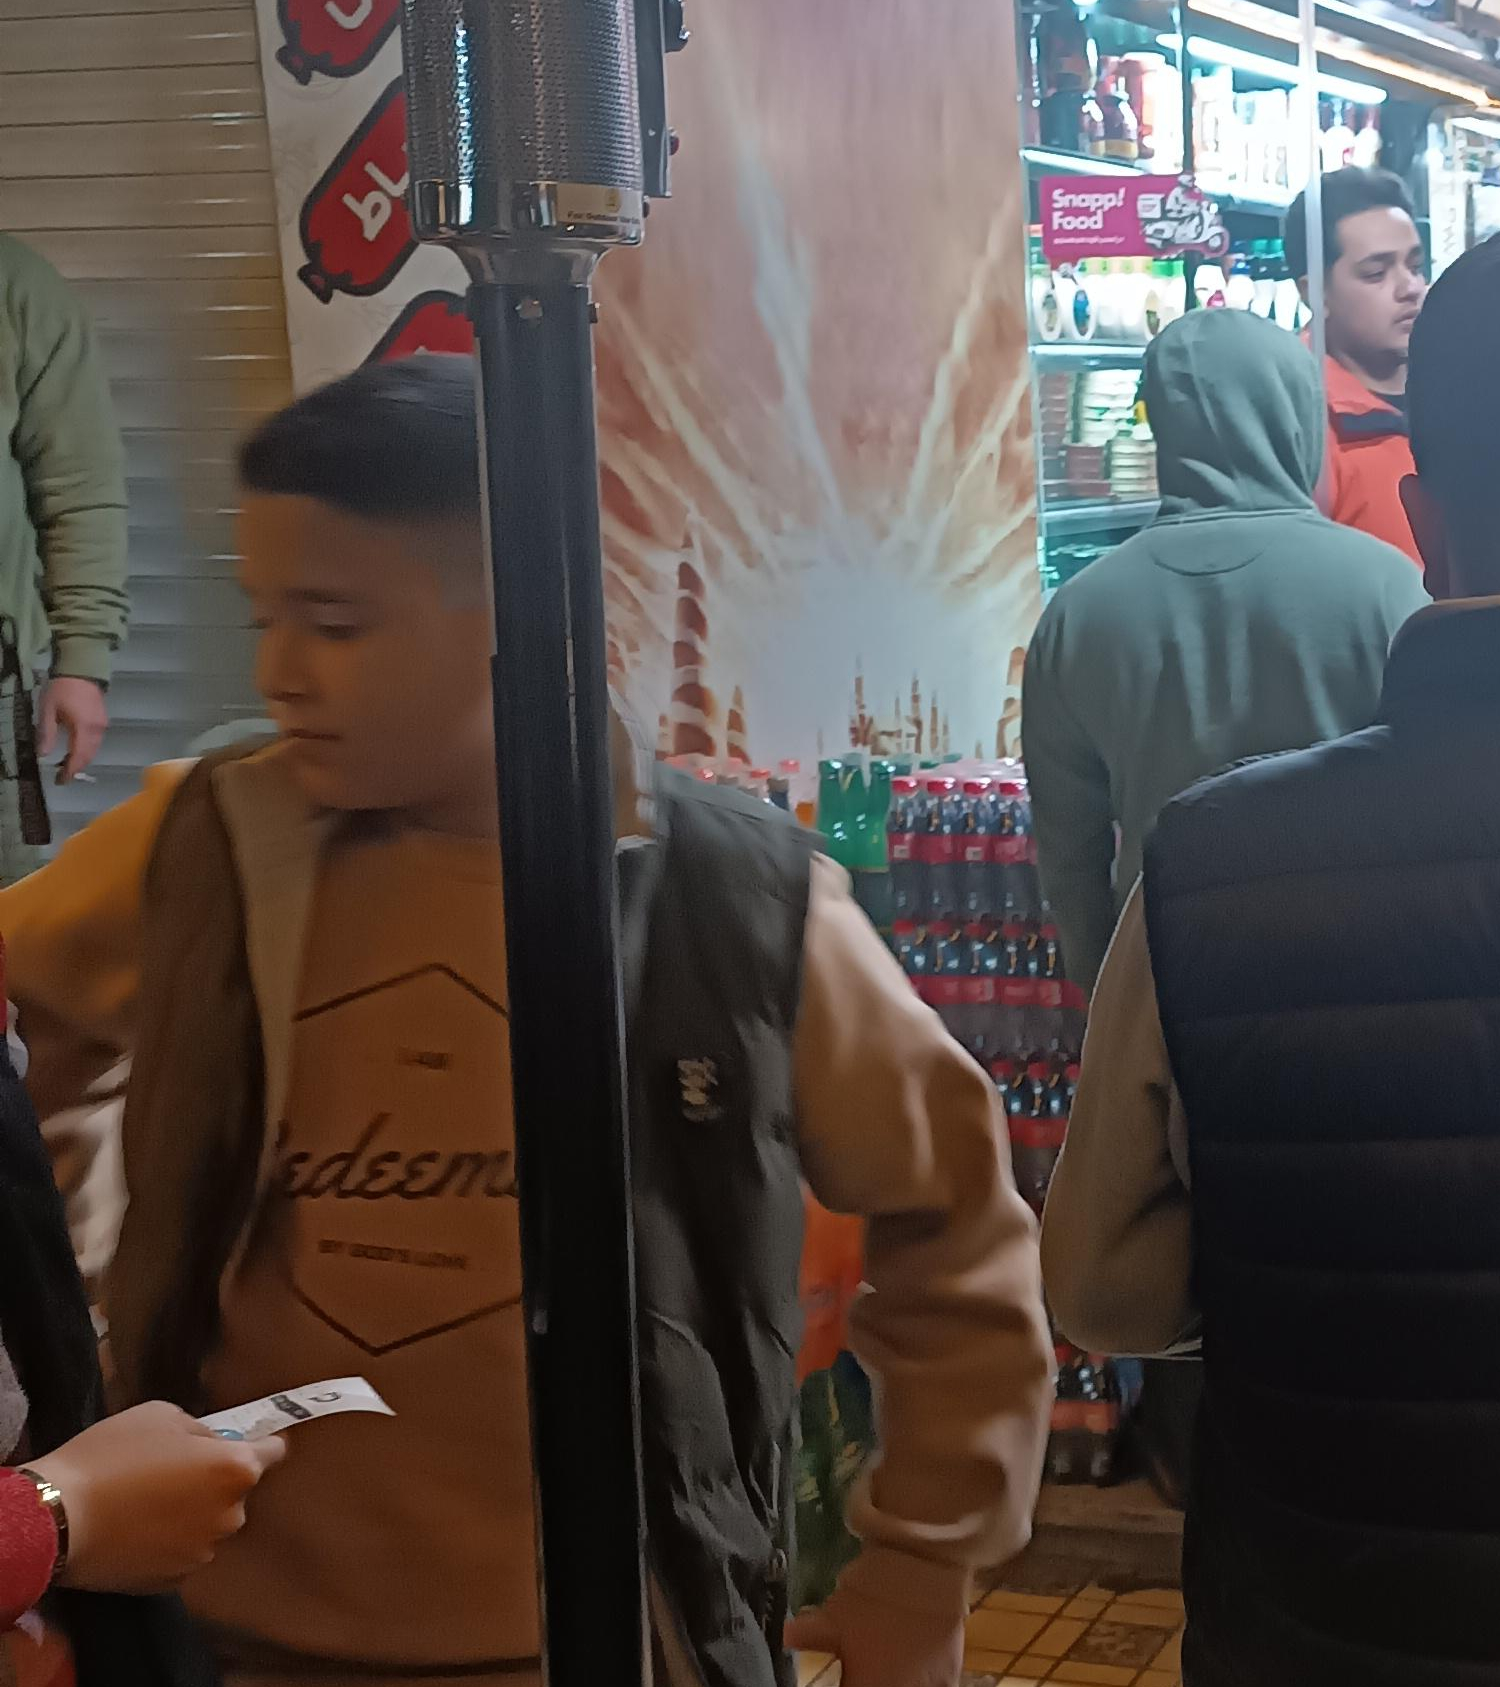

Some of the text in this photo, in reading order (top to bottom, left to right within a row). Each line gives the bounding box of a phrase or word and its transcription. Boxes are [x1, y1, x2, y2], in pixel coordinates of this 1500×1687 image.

[1052, 187, 1126, 211] Snapp!
[1052, 211, 1103, 231] Food
[277, 1112, 518, 1200] edeem
